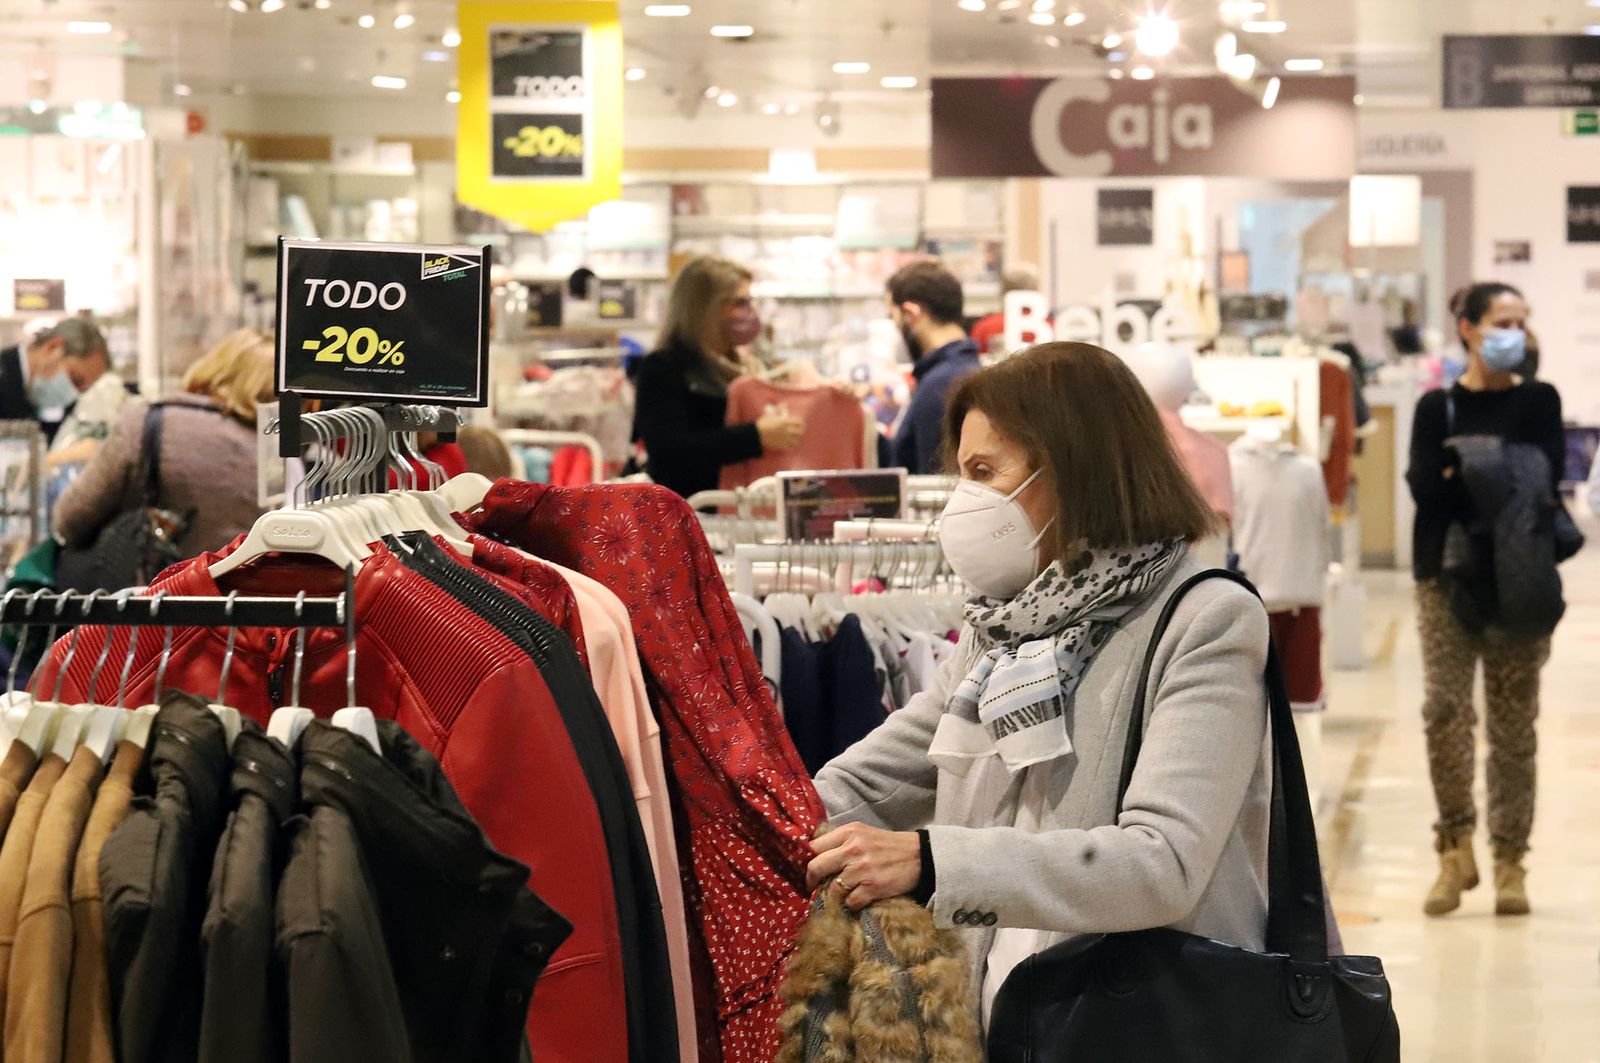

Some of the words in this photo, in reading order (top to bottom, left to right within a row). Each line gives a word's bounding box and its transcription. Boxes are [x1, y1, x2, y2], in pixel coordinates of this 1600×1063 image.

[513, 75, 583, 97] TODO
[1031, 77, 1213, 177] Caja
[503, 126, 583, 157] -20%
[424, 256, 450, 269] BLACK
[424, 263, 450, 276] FRIDAY
[442, 270, 467, 282] TOTAL
[303, 278, 407, 311] TODO
[302, 325, 405, 366] -20%
